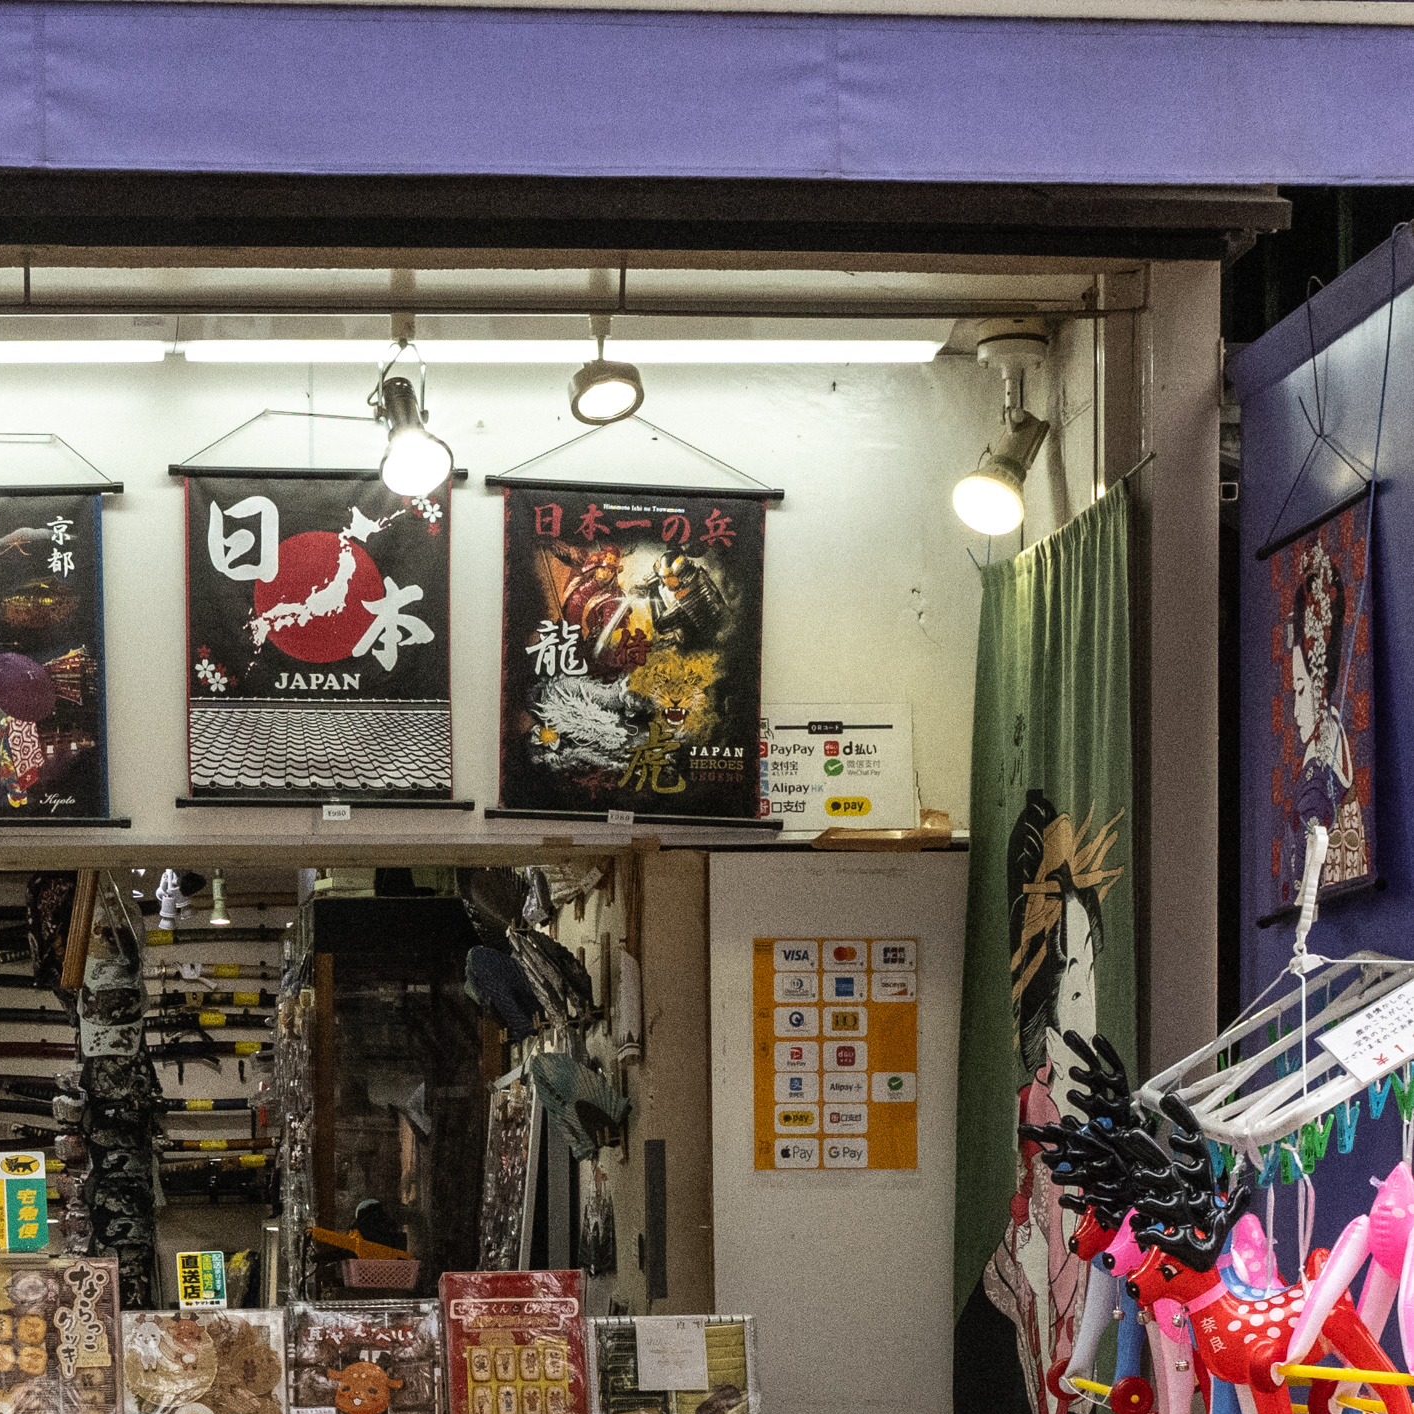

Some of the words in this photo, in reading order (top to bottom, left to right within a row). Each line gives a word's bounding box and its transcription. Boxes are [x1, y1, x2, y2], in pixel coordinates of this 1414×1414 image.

[534, 503, 737, 547] 日本一の兵
[47, 515, 75, 577] 京都
[526, 620, 588, 676] 龍
[274, 672, 361, 691] JAPAN
[619, 722, 686, 793] 虎
[690, 746, 744, 758] JAPAN
[770, 744, 815, 757] PayPay
[690, 759, 744, 771] HEROES
[771, 761, 799, 771] 支付宝
[771, 783, 810, 794] Alipay
[40, 792, 76, 813] Kyoto
[843, 800, 864, 811] pay
[782, 950, 809, 961] VISA
[792, 1148, 813, 1162] Pay
[843, 1148, 862, 1162] Pay
[17, 1188, 39, 1239] 宅急便
[181, 1255, 201, 1300] 直送店
[66, 1263, 108, 1351] ならっこ
[1201, 1316, 1227, 1354] 奈良
